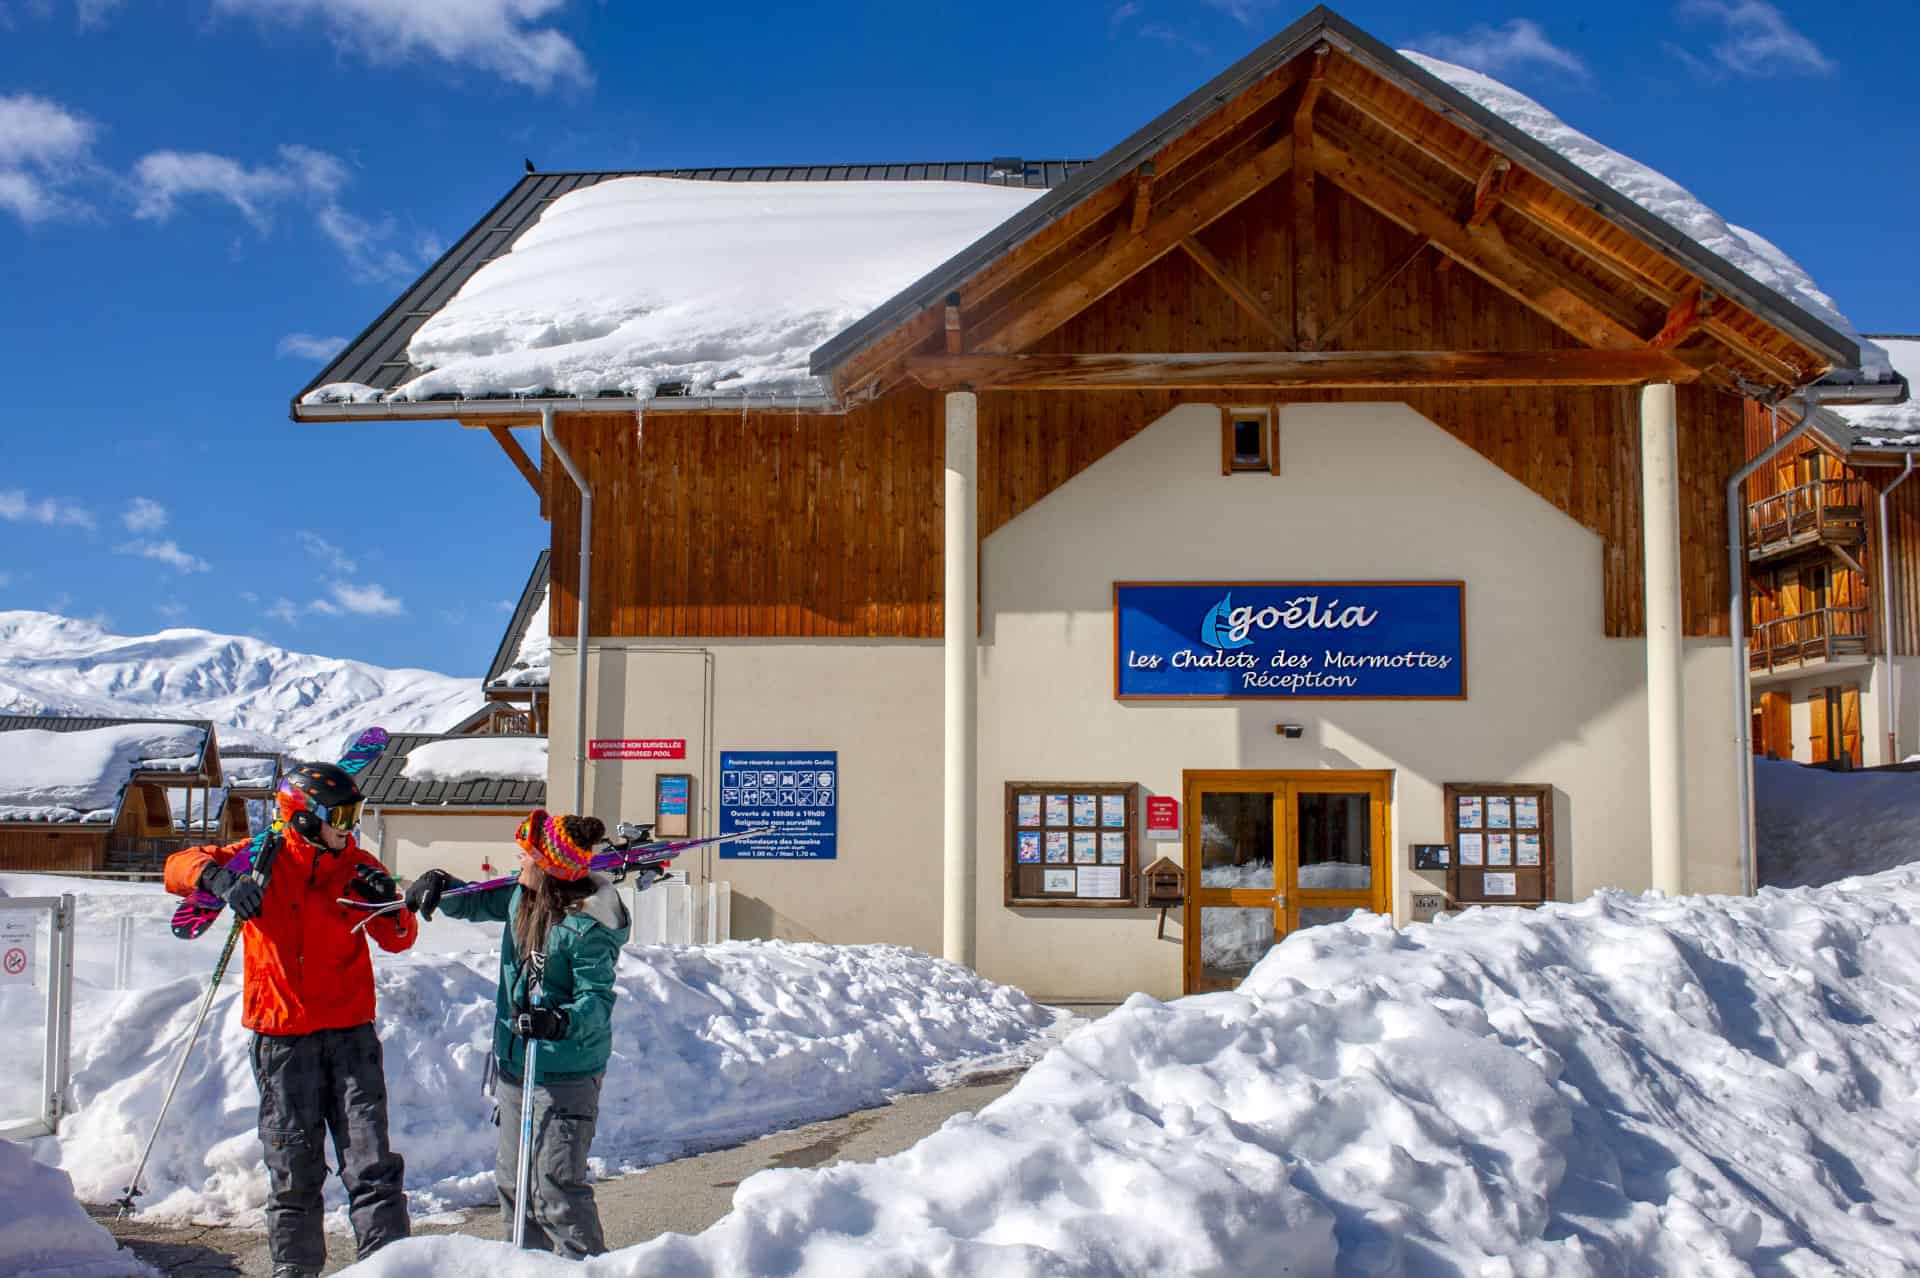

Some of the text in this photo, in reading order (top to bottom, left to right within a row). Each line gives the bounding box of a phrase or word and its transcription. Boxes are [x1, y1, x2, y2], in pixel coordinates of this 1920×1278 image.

[1128, 650, 1453, 669] Les Chalets des Marmottes
[1242, 671, 1357, 693] Réception
